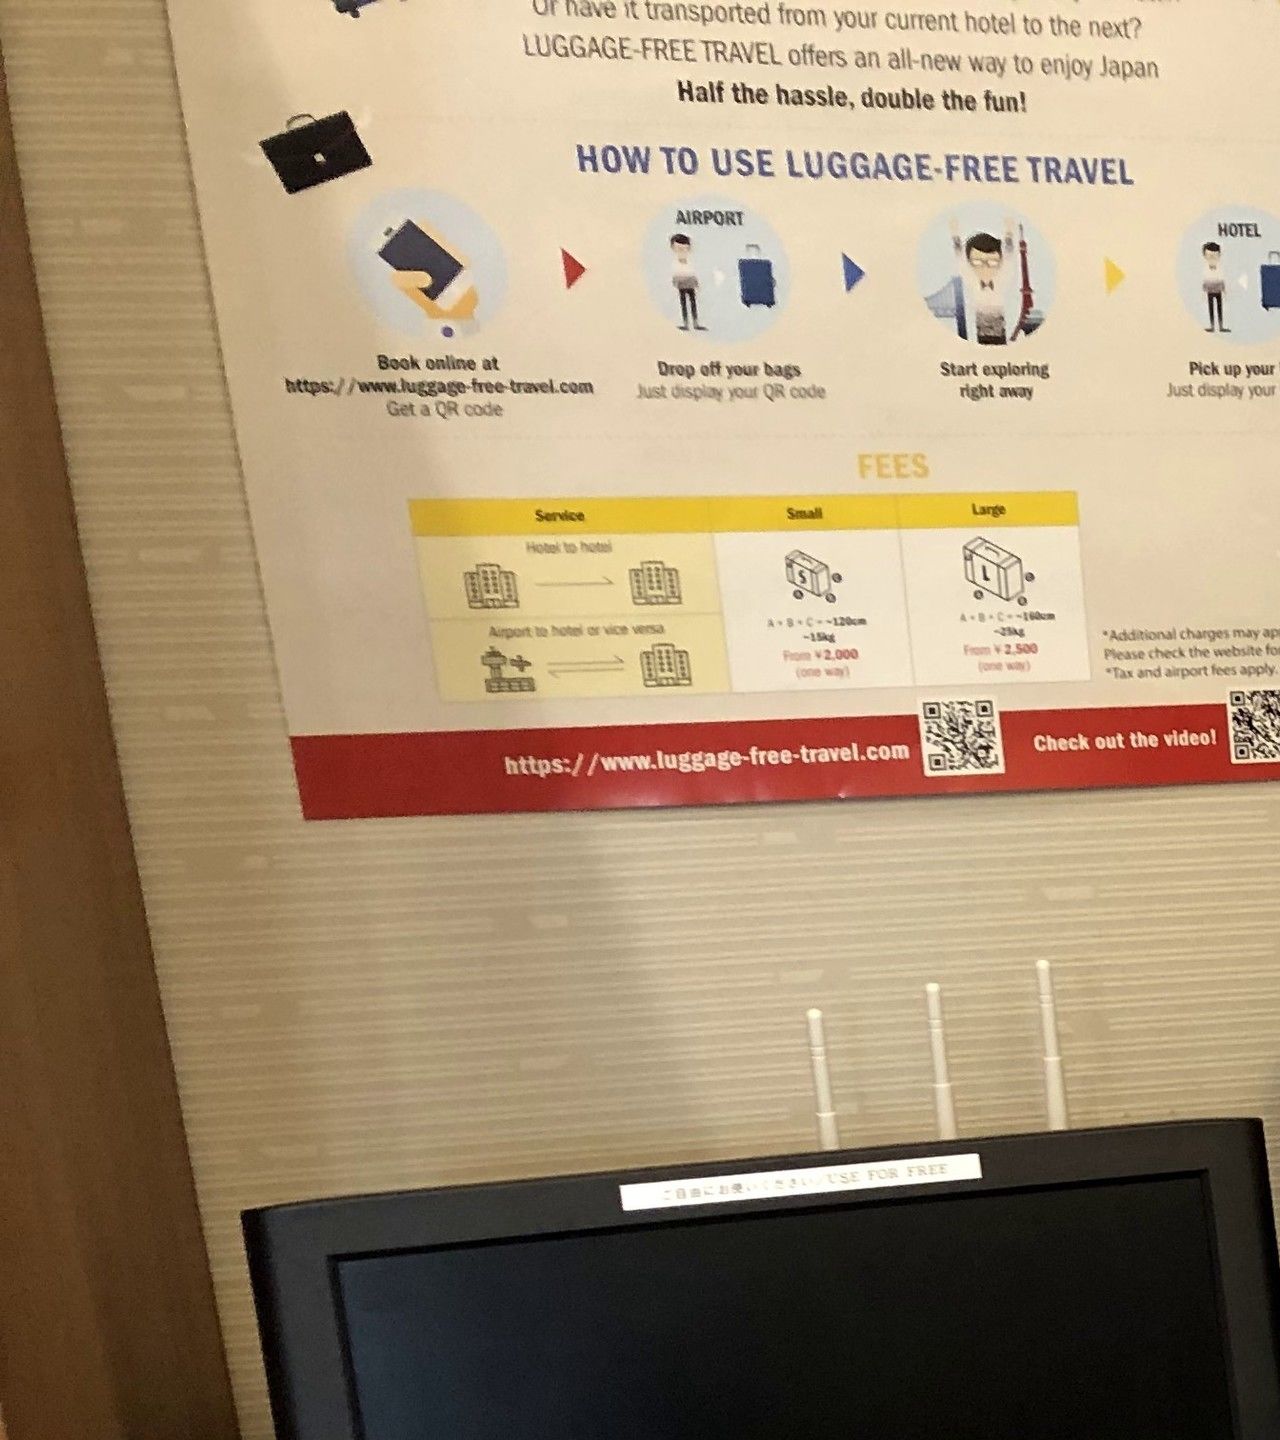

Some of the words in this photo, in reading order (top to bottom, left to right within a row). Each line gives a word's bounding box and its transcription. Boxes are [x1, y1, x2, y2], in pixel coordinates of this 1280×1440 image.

[566, 0, 616, 20] have
[625, 0, 639, 20] it
[645, 1, 770, 26] transported
[777, 6, 826, 27] from
[834, 11, 877, 31] your
[885, 10, 957, 32] current
[965, 12, 1015, 35] hotel
[1023, 16, 1042, 36] to
[1049, 16, 1081, 37] the
[1089, 18, 1142, 39] next?
[522, 33, 697, 62] LUGGAGE-FREE
[701, 40, 782, 66] TRAVEL
[788, 43, 848, 68] offers
[854, 50, 880, 69] an
[887, 48, 961, 72] all-new
[968, 55, 1006, 78] way
[1013, 53, 1033, 75] to
[1041, 56, 1092, 81] enjoy
[1099, 55, 1160, 82] Japan
[677, 80, 725, 104] Half
[732, 82, 768, 105] the
[775, 83, 855, 110] hassle,
[861, 87, 935, 111] double
[941, 89, 977, 112] the
[983, 89, 1027, 113] fun!
[576, 144, 650, 174] HOW
[659, 146, 699, 176] TO
[711, 148, 775, 178] USE
[786, 150, 1019, 183] LUGGAGE-FREE
[1026, 156, 1134, 186] TRAVEL
[676, 210, 744, 226] AIRPORT
[1218, 222, 1261, 238] HOTEL
[377, 354, 421, 371] Book
[426, 355, 476, 371] online
[482, 355, 500, 371] at
[657, 360, 695, 380] Drop
[700, 361, 721, 377] off
[726, 364, 759, 381] your
[763, 361, 801, 381] bags
[940, 362, 978, 377] Start
[982, 363, 1050, 380] exploring
[1189, 362, 1220, 376] Pick
[1223, 366, 1241, 379] up
[1245, 366, 1275, 379] your
[284, 378, 594, 397] https://www.luggage-free-travel.com
[637, 384, 666, 400] Just
[672, 383, 722, 402] display
[728, 386, 758, 402] your
[763, 384, 784, 401] QR
[790, 384, 826, 400] code
[960, 382, 994, 400] right
[999, 386, 1033, 400] away
[1167, 383, 1194, 397] Just
[1198, 383, 1244, 399] display
[1248, 386, 1276, 399] your
[387, 401, 415, 417] Get
[421, 405, 431, 417] a
[435, 401, 459, 419] QR
[464, 402, 503, 417] code
[857, 453, 931, 480] FEES
[535, 510, 585, 523] Service
[787, 507, 823, 520] Small
[972, 503, 1006, 517] Large
[526, 541, 561, 554] Hotel
[563, 542, 578, 553] to
[580, 540, 613, 553] hotel
[488, 626, 532, 640] Airport
[535, 626, 549, 638] to
[551, 625, 584, 638] hotel
[603, 624, 629, 636] vice
[632, 624, 665, 636] versa
[1180, 628, 1229, 644] charges
[1232, 629, 1255, 643] may
[1104, 647, 1145, 661] Please
[1149, 647, 1185, 660] check
[1189, 647, 1209, 660] the
[1213, 644, 1263, 659] website
[1136, 665, 1161, 679] and
[1165, 665, 1209, 680] airport
[1212, 663, 1237, 677] fees
[1240, 663, 1278, 679] apply.
[1034, 734, 1089, 751] Check
[1095, 734, 1124, 750] out
[1130, 732, 1159, 748] the
[1165, 729, 1216, 747] video!
[505, 743, 909, 776] https://www.luggage-free-travel.com
[868, 1167, 898, 1181] FOR
[907, 1163, 948, 1177] FREE
